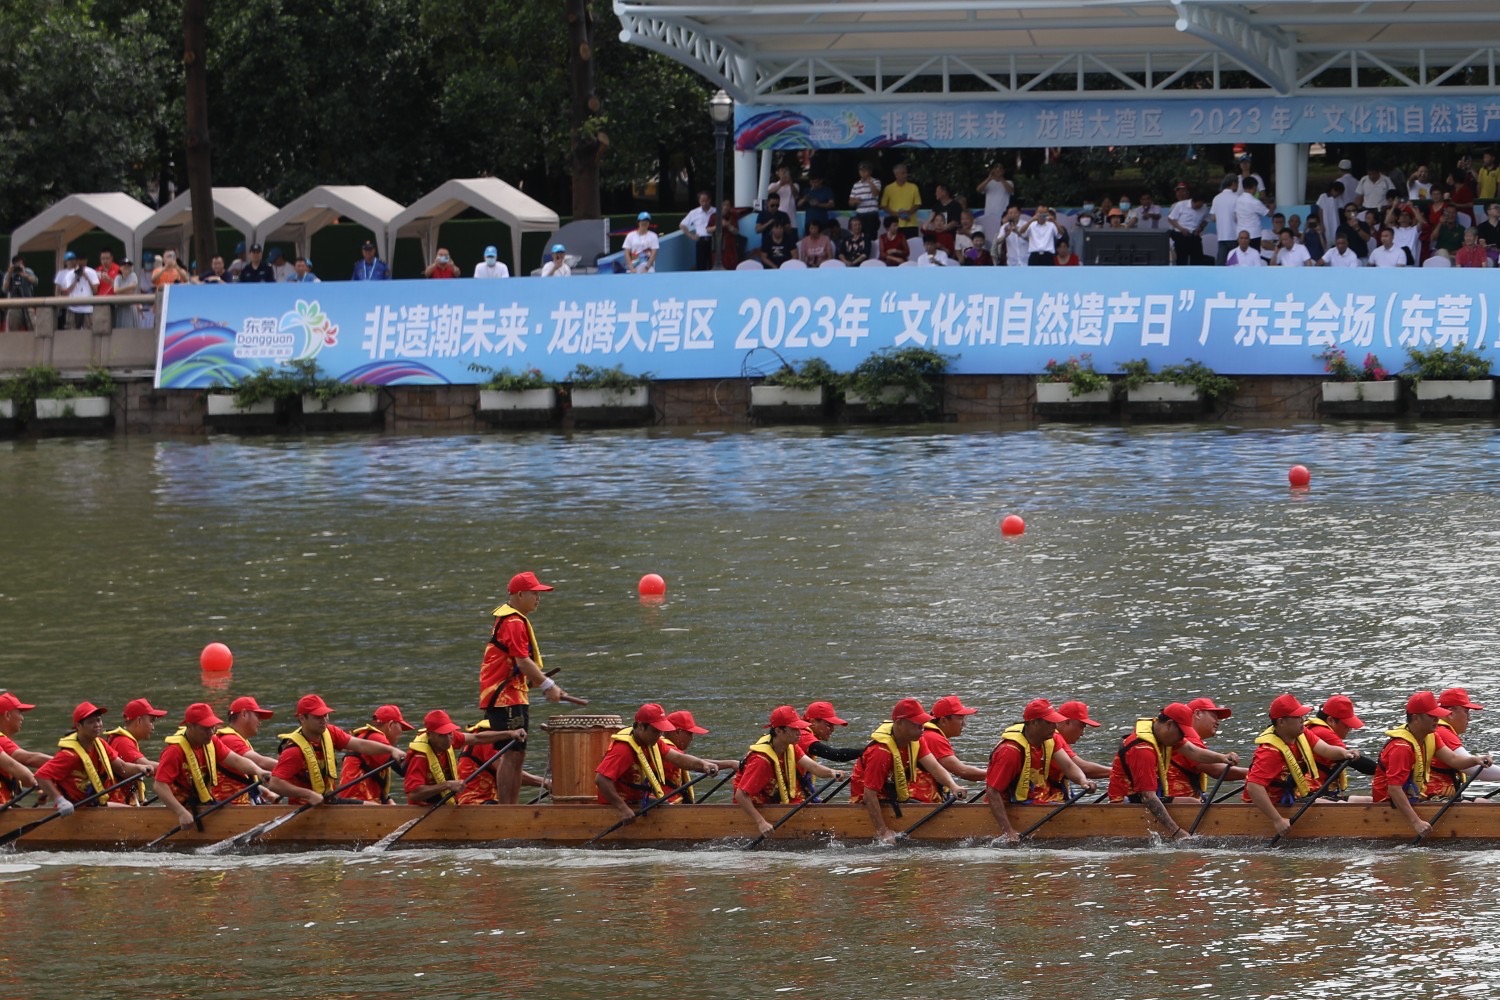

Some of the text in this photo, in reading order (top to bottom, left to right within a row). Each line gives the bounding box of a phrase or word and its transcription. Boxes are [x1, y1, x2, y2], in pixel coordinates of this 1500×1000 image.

[245, 318, 275, 333] 东莞
[362, 298, 718, 360] 非遗潮未来·龙腾大湾区
[237, 334, 292, 347] Dongguan
